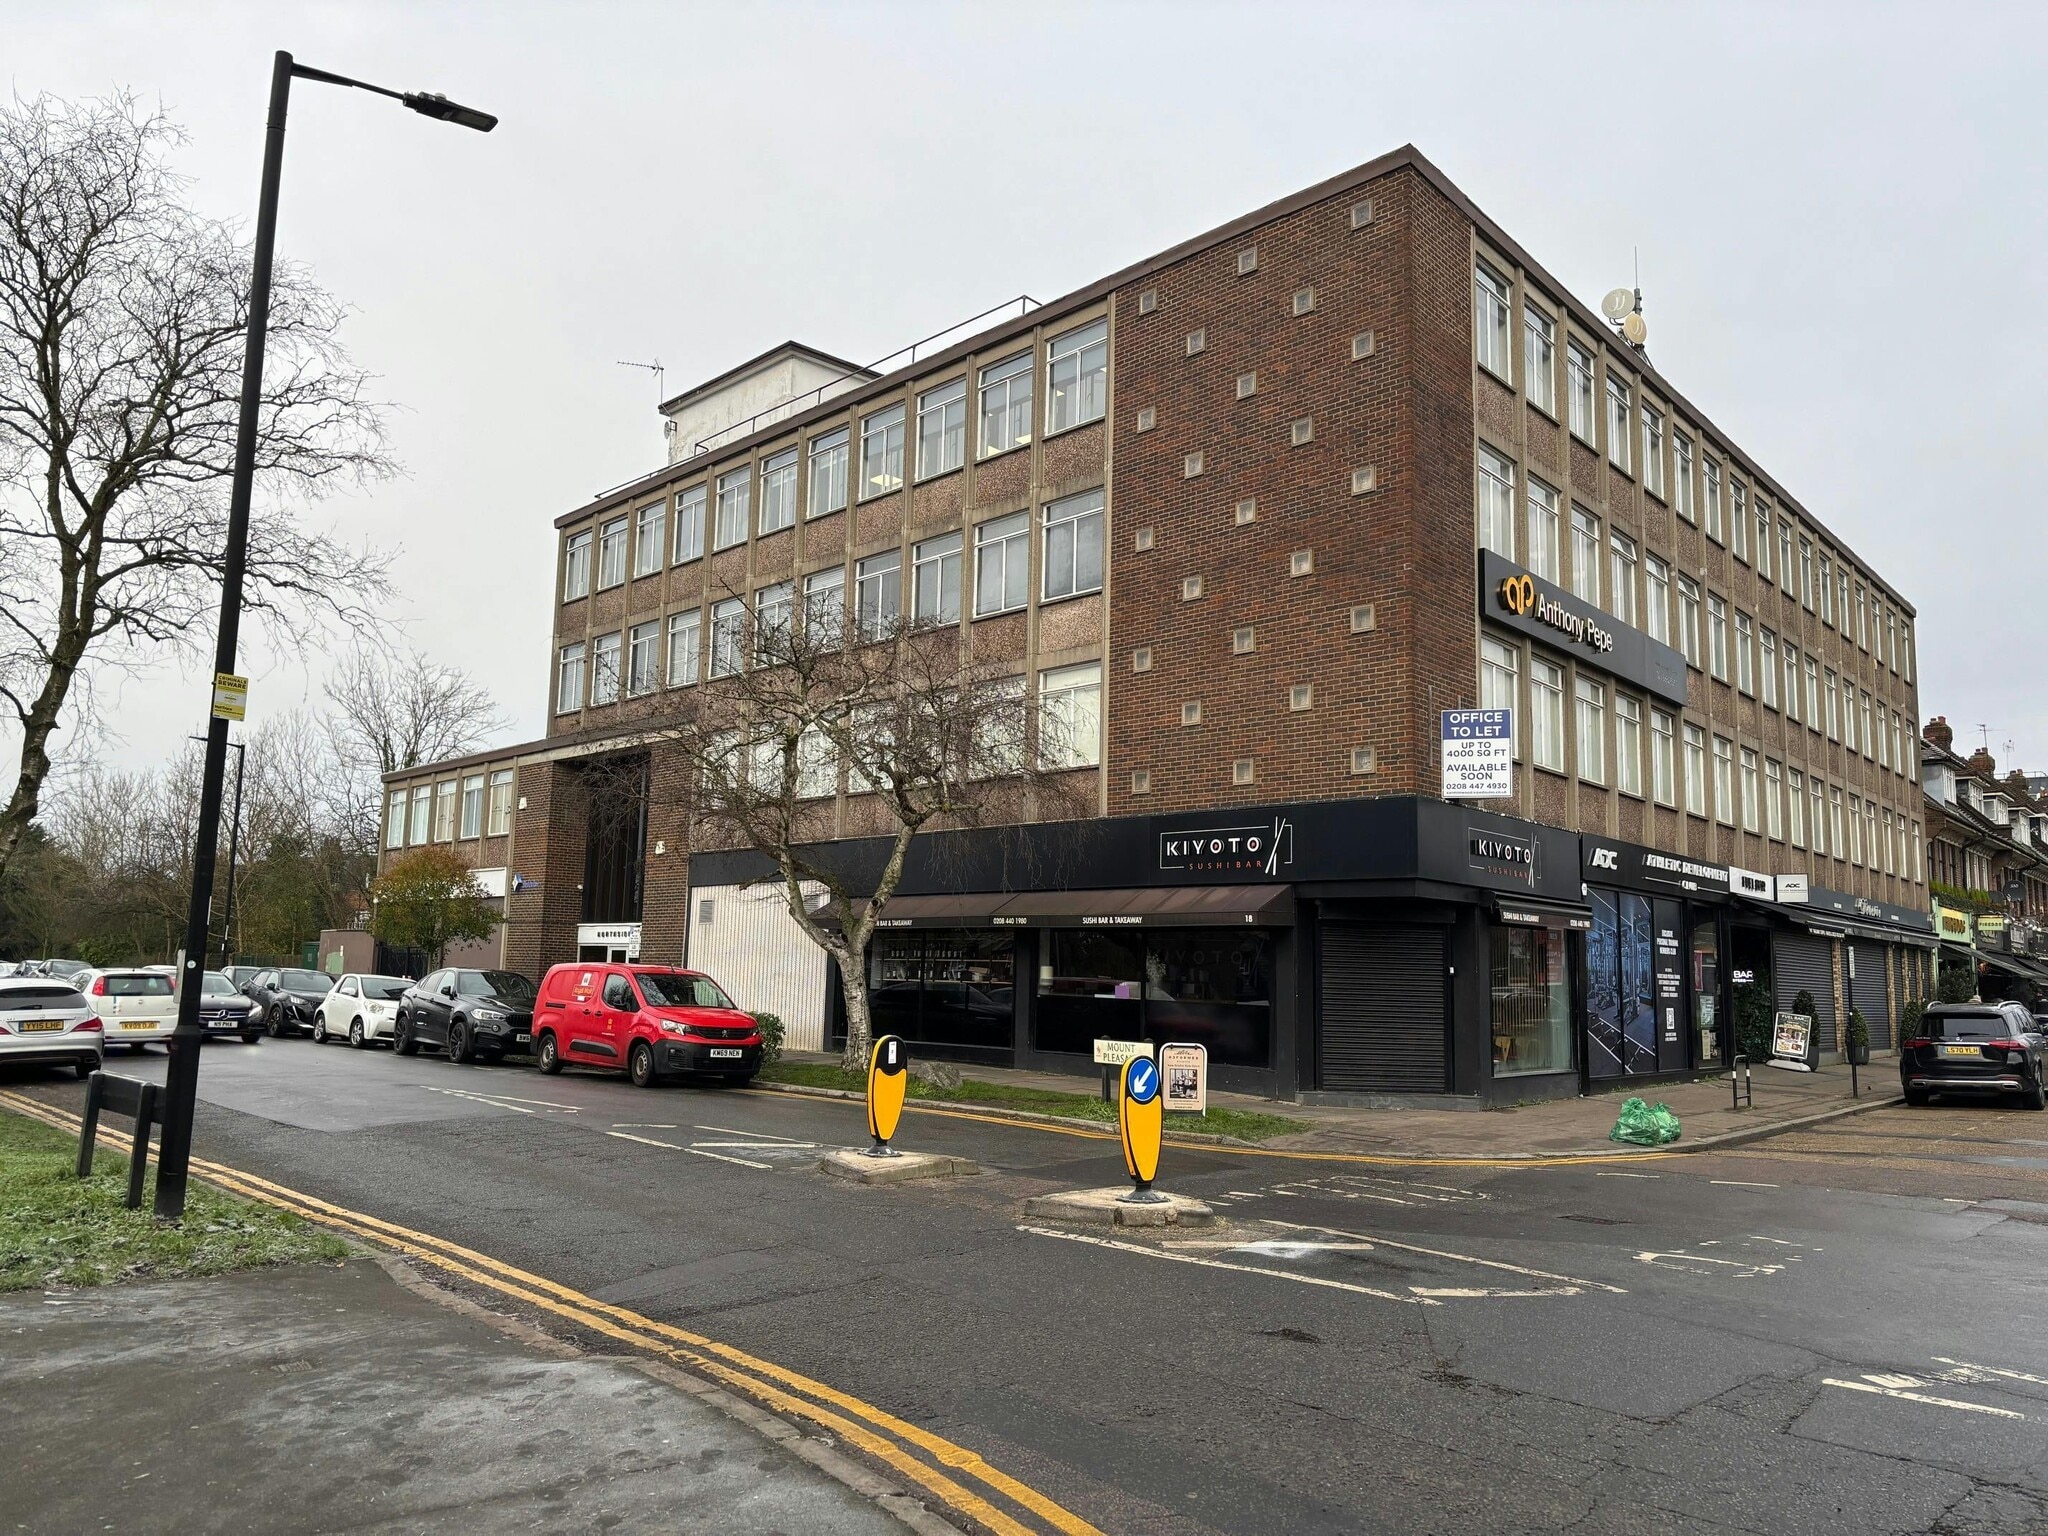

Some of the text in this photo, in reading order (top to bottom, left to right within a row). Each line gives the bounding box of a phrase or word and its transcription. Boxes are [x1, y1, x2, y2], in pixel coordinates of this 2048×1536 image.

[1538, 593, 1613, 652] Anthony Pepe
[218, 676, 246, 684] CRIMINALS
[218, 680, 246, 689] BEWARE
[1450, 712, 1503, 724] OFFICE
[1451, 726, 1502, 737] TO LET
[1446, 763, 1507, 772] AVAILABLE
[1166, 837, 1260, 856] KIYOTO
[1478, 839, 1531, 864] KIYOTO
[1592, 848, 1618, 870] ADC
[1189, 862, 1230, 870] SUSHI
[1488, 866, 1512, 875] SUSHI
[1646, 854, 1728, 882] ATHLETIC DEVELOPMENT
[1082, 916, 1097, 924] SUSHI
[1245, 914, 1253, 923] 18
[1107, 1042, 1136, 1053] MOUNT
[1103, 1053, 1129, 1063] PLEASA
